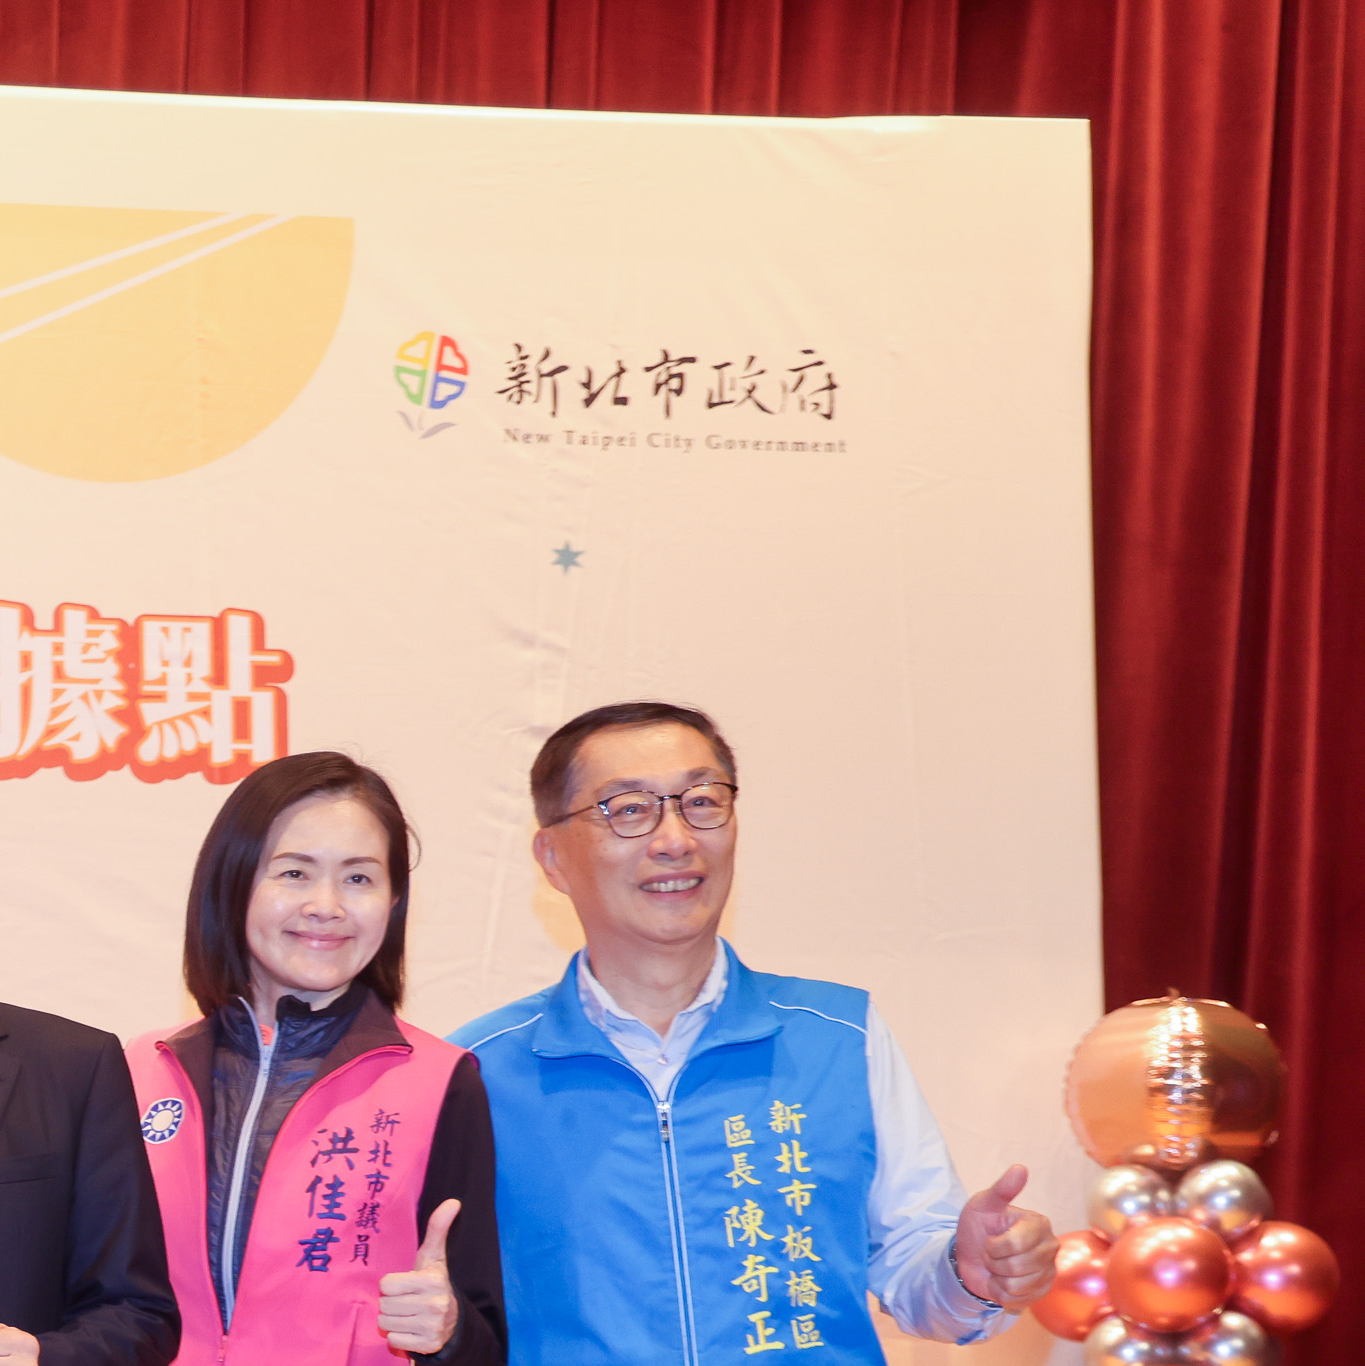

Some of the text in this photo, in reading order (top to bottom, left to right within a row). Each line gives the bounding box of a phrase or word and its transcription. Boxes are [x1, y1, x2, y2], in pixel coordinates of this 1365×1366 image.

[495, 342, 841, 421] 新北市政府
[503, 428, 849, 454] New Taipei City Government
[296, 1126, 360, 1273] 洪佳君
[349, 1108, 401, 1266] 新北市議員
[723, 1114, 786, 1355] 區長 陳奇正
[768, 1100, 825, 1350] 新北市板橋區
